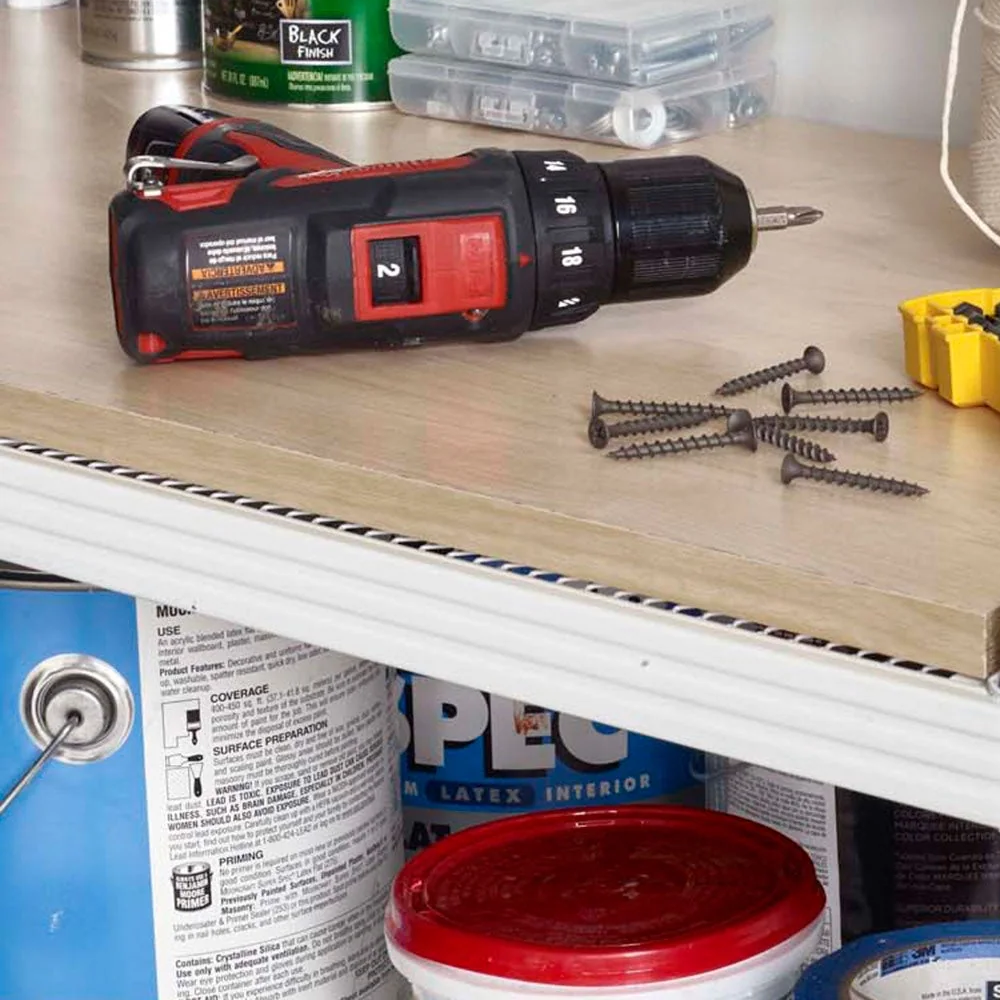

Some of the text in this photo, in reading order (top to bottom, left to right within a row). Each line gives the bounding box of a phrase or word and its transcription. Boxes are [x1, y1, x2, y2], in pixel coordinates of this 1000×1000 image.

[288, 24, 342, 45] BLACK
[297, 47, 335, 59] FINISH
[554, 195, 578, 215] 16
[561, 246, 584, 267] 18
[377, 263, 401, 278] 2
[157, 625, 181, 637] USE
[159, 666, 188, 678] Product
[210, 684, 270, 704] COVERAGE
[397, 675, 629, 771] PEC
[213, 738, 263, 757] SURFACE
[265, 718, 329, 746] PREPARATION
[206, 796, 227, 808] LEAD
[228, 794, 237, 804] IS
[265, 778, 300, 796] EXPOSURE
[313, 767, 329, 782] LEAD
[206, 776, 334, 817] SUCH AS BRAIN ESPECIALLY
[215, 780, 253, 796] WARNING!
[440, 785, 522, 803] LATEX
[545, 773, 652, 802] INTERIOR
[167, 806, 276, 832] WOMEN SHOULD ALSO AVOID
[219, 850, 264, 867] PRIMING
[220, 885, 286, 905] Previously Painted
[215, 948, 257, 963] Crystalline
[259, 943, 280, 955] Silica
[176, 970, 192, 979] Use
[195, 966, 212, 977] only
[214, 962, 232, 973] with
[234, 956, 269, 970] adequate
